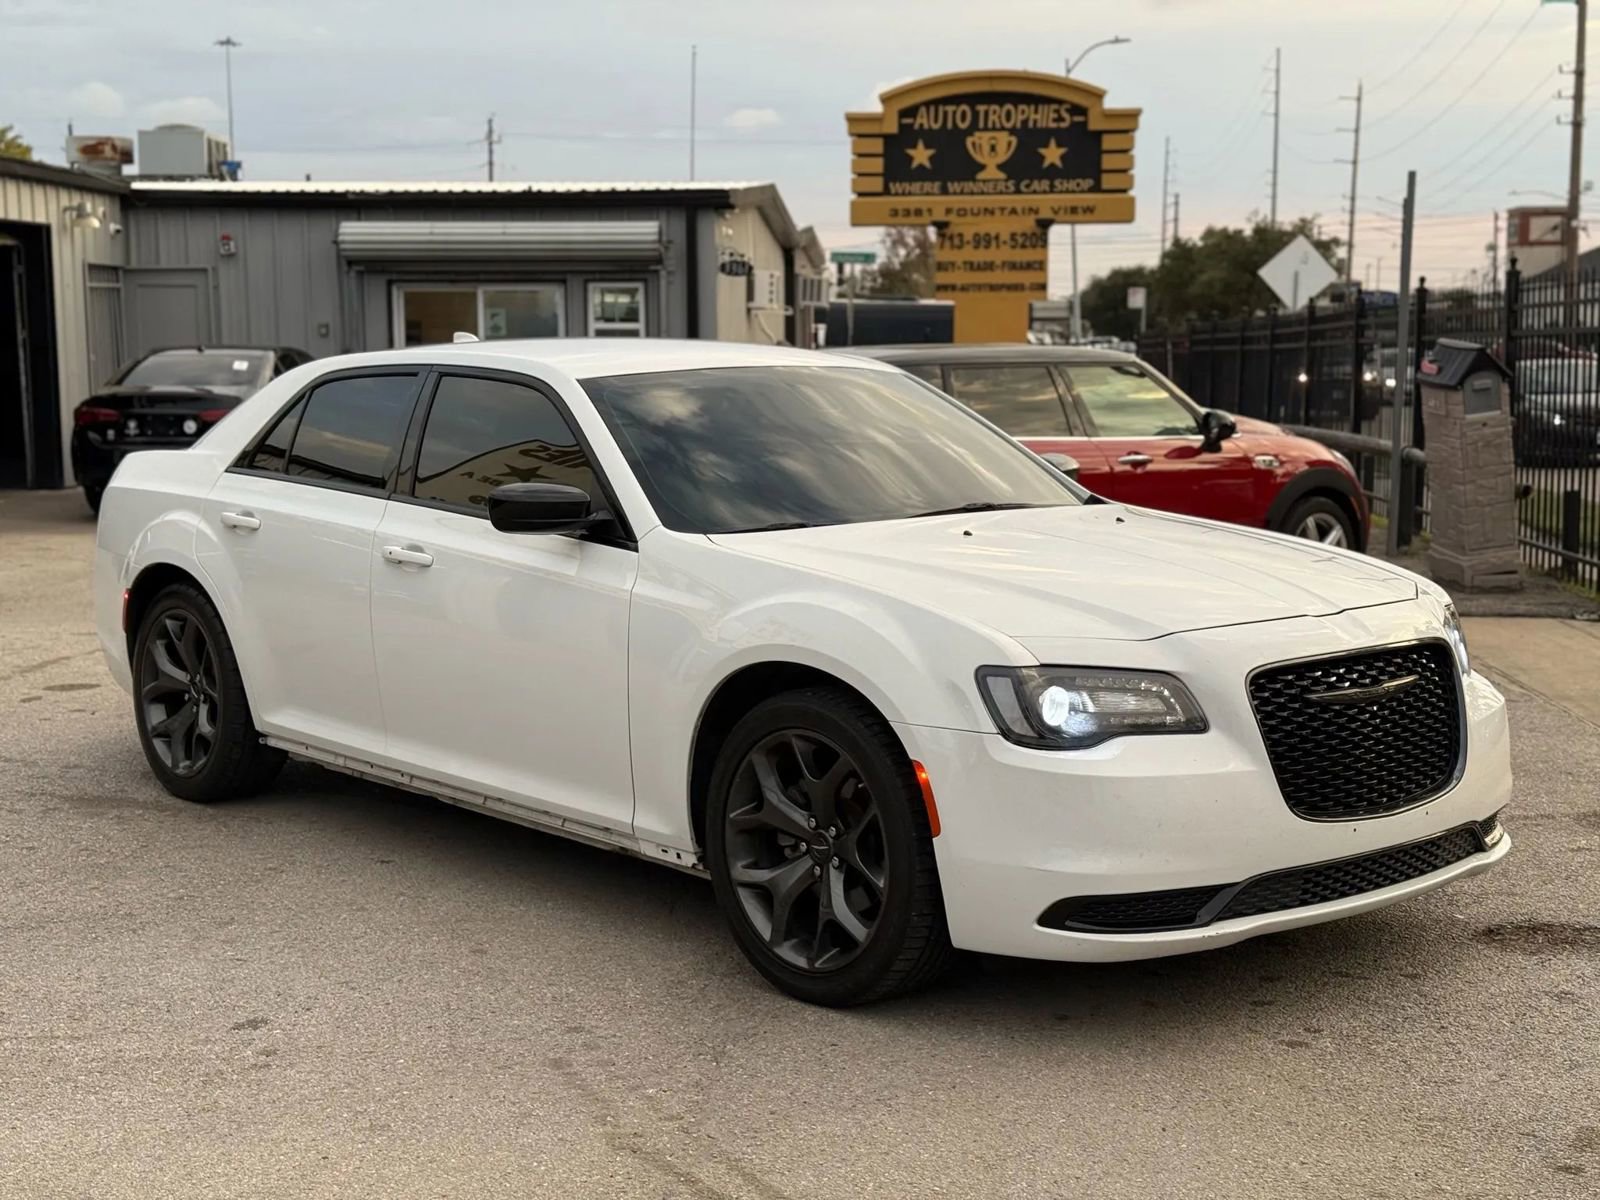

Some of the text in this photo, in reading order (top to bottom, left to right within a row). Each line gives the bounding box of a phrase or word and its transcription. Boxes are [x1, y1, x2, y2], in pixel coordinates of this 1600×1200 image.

[889, 178, 1094, 194] WHERE WINNERS CAR SHOP
[889, 204, 1096, 217] 3381 FOUNTAIN VIEW
